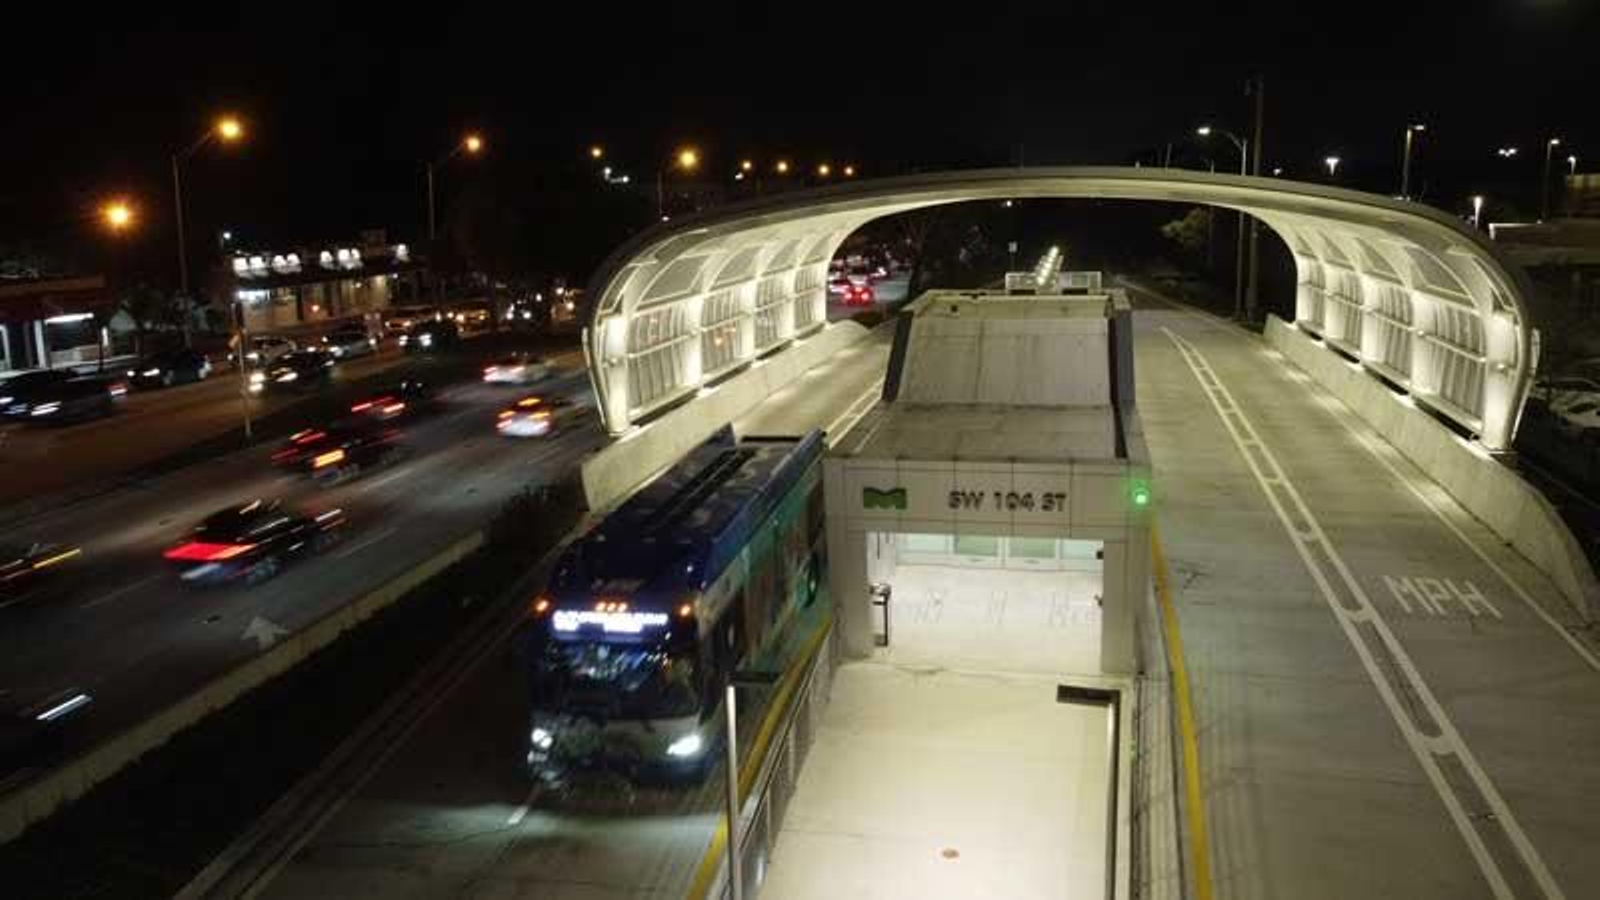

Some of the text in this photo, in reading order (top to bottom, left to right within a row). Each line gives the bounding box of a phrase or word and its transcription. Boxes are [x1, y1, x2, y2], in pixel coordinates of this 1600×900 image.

[949, 490, 1067, 511] SW 104 ST
[1384, 575, 1502, 618] MPH
